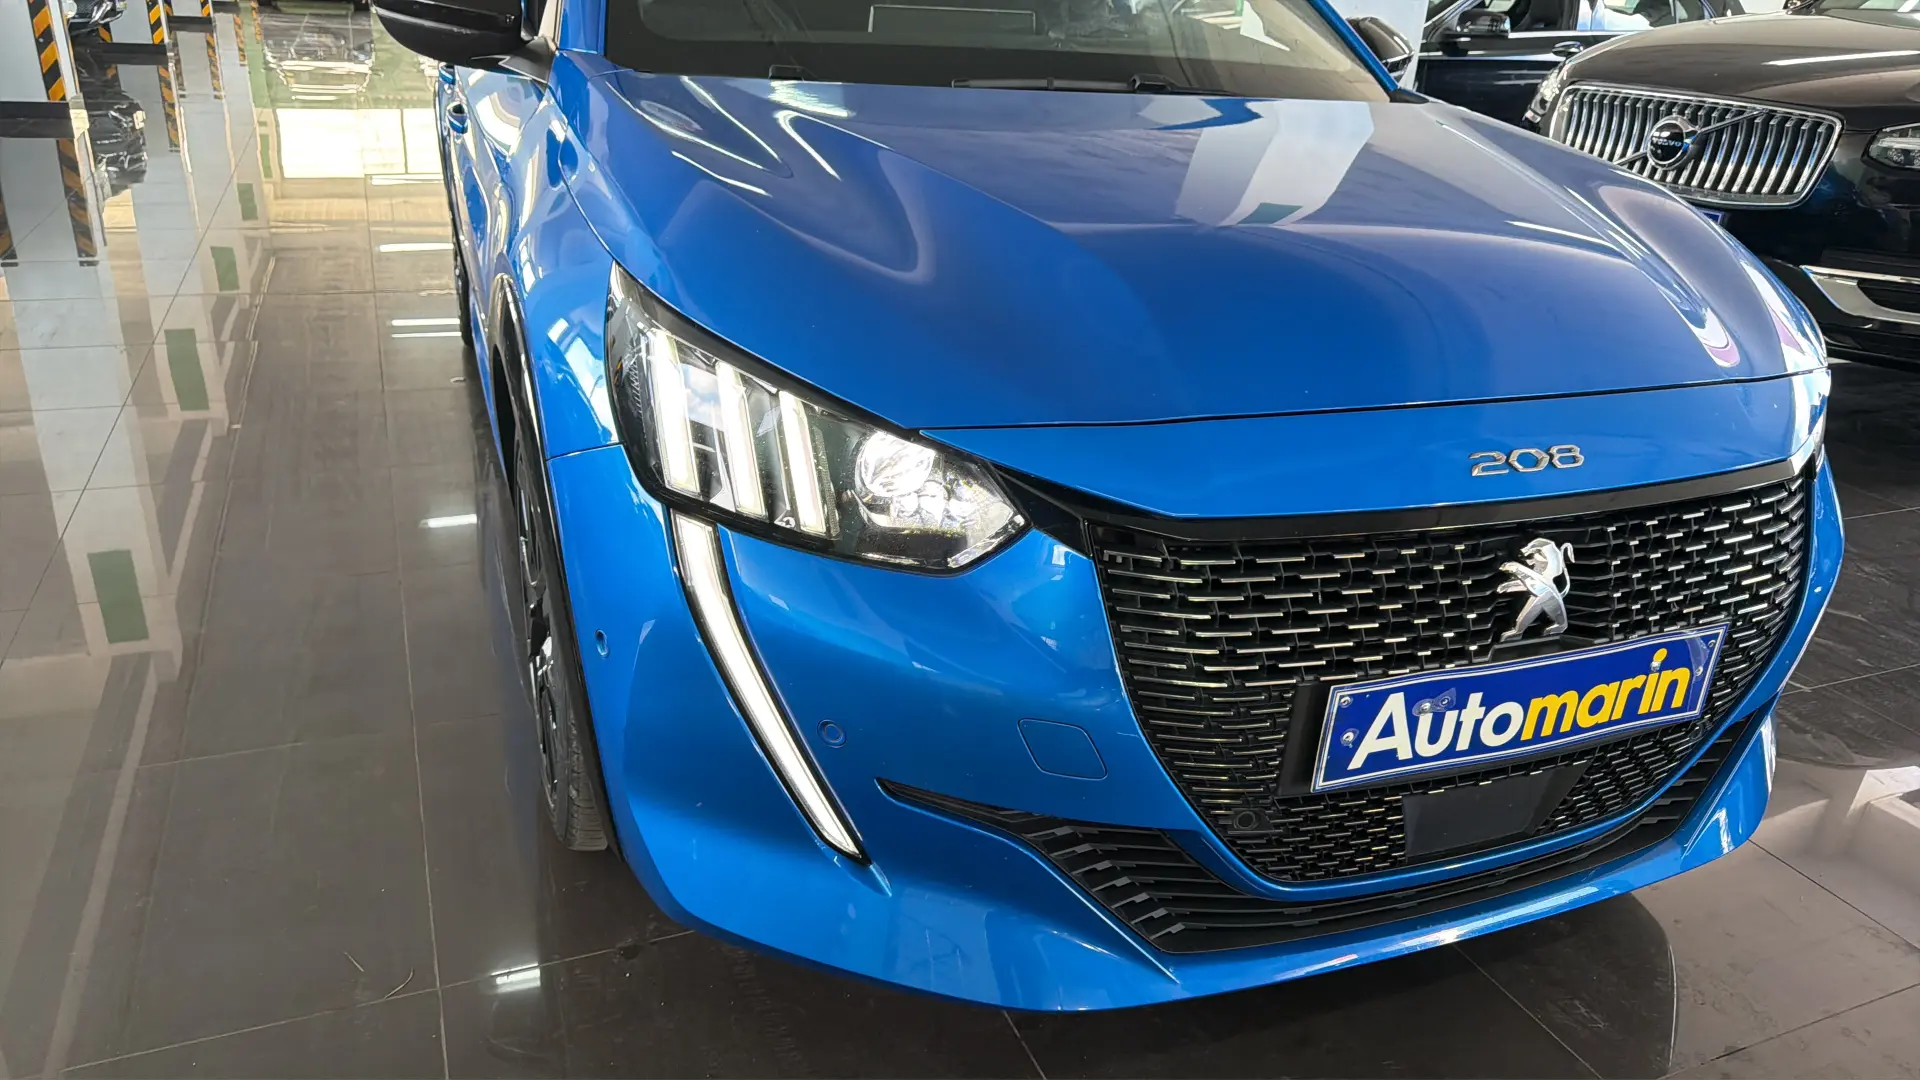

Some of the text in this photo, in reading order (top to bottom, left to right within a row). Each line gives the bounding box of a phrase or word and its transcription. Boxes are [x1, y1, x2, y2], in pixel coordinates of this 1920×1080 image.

[1651, 137, 1682, 147] VOLVO
[1469, 445, 1585, 476] 208
[1347, 648, 1691, 770] Automarin
